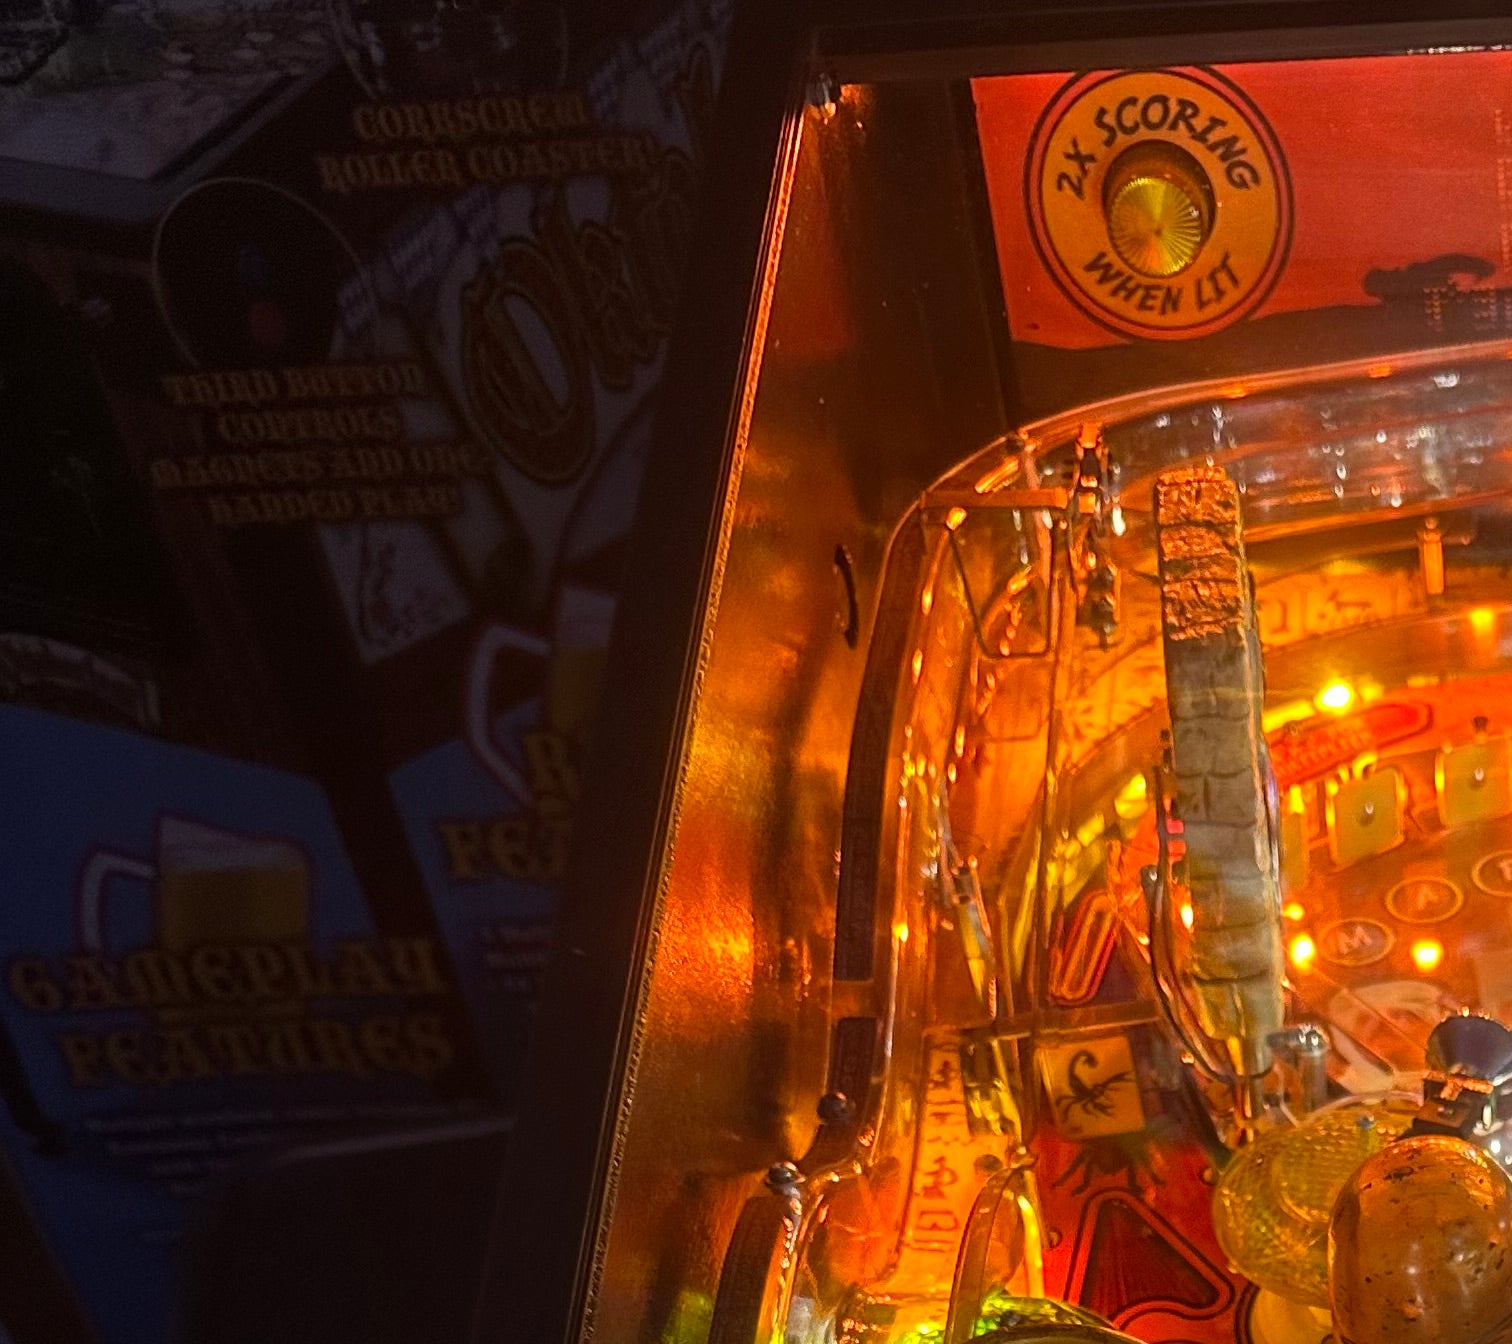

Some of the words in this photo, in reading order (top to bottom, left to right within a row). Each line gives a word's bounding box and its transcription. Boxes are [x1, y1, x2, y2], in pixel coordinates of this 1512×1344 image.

[316, 149, 466, 198] ROLLER
[1056, 137, 1097, 201] 2X
[1094, 94, 1261, 192] SCORING
[1083, 250, 1183, 317] WHEN
[1194, 250, 1241, 310] LIT
[8, 936, 450, 1014] GAMEPLAY
[58, 1012, 455, 1090] FEATURES
